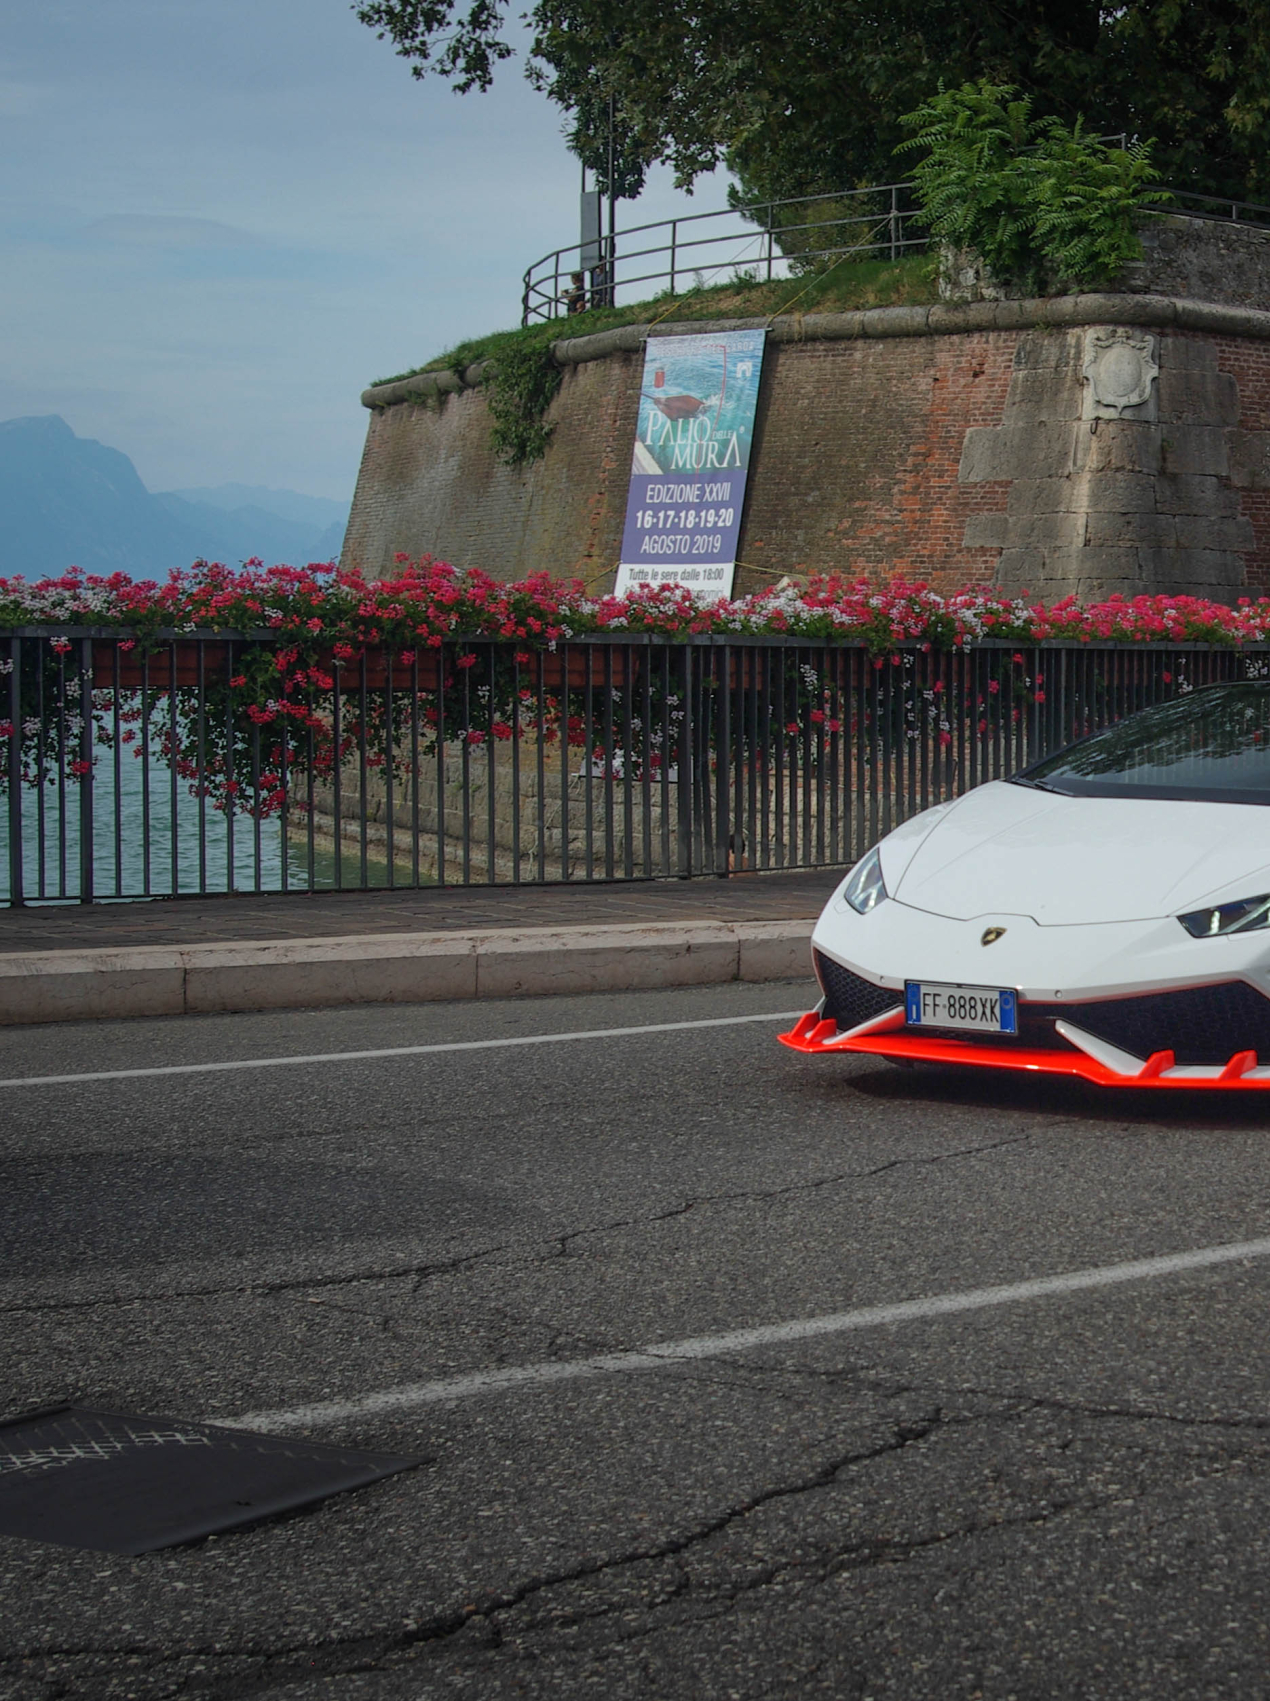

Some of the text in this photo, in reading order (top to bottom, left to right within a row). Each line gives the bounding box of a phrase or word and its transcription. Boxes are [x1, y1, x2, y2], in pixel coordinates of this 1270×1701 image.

[645, 410, 711, 446] PALIO
[712, 430, 733, 440] DELLE
[670, 431, 741, 470] MURA
[645, 482, 731, 503] EDIZIONE XXVII
[640, 534, 722, 555] AGOSTO 2019
[629, 568, 724, 581] Tutte le sere dalle 18:00
